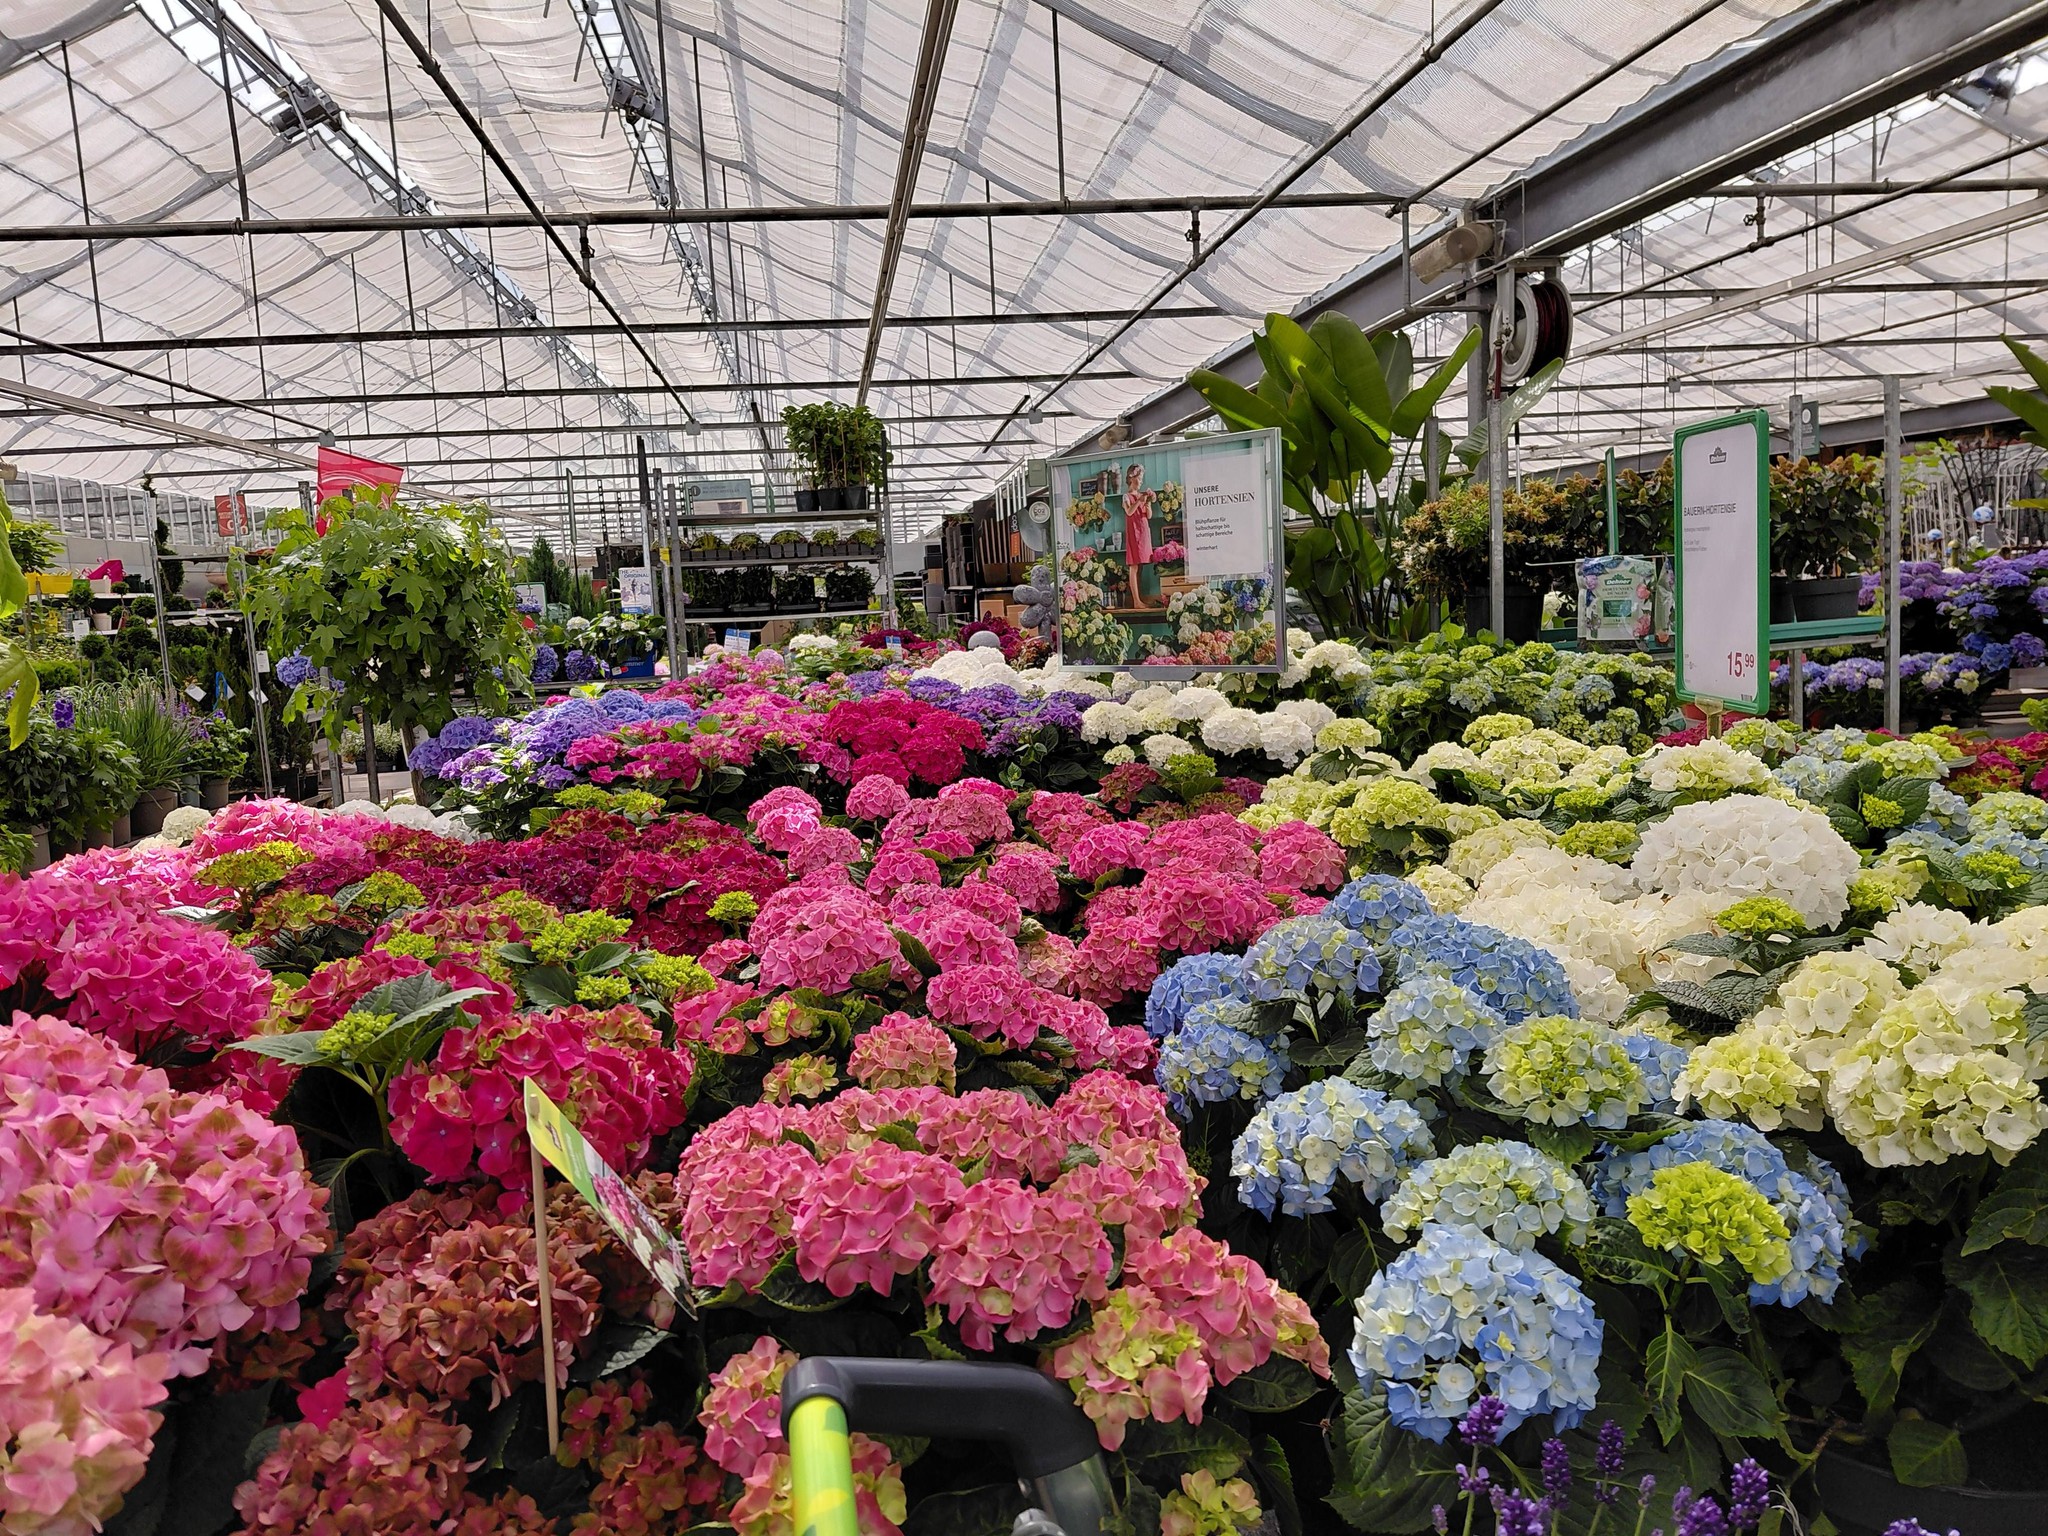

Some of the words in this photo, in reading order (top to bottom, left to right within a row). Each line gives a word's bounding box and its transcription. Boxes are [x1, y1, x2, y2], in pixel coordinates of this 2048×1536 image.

[1194, 485, 1219, 494] UNSERE
[1195, 492, 1255, 507] HORTENSIEN
[1684, 503, 1736, 516] BAUERN-HORTENSIE
